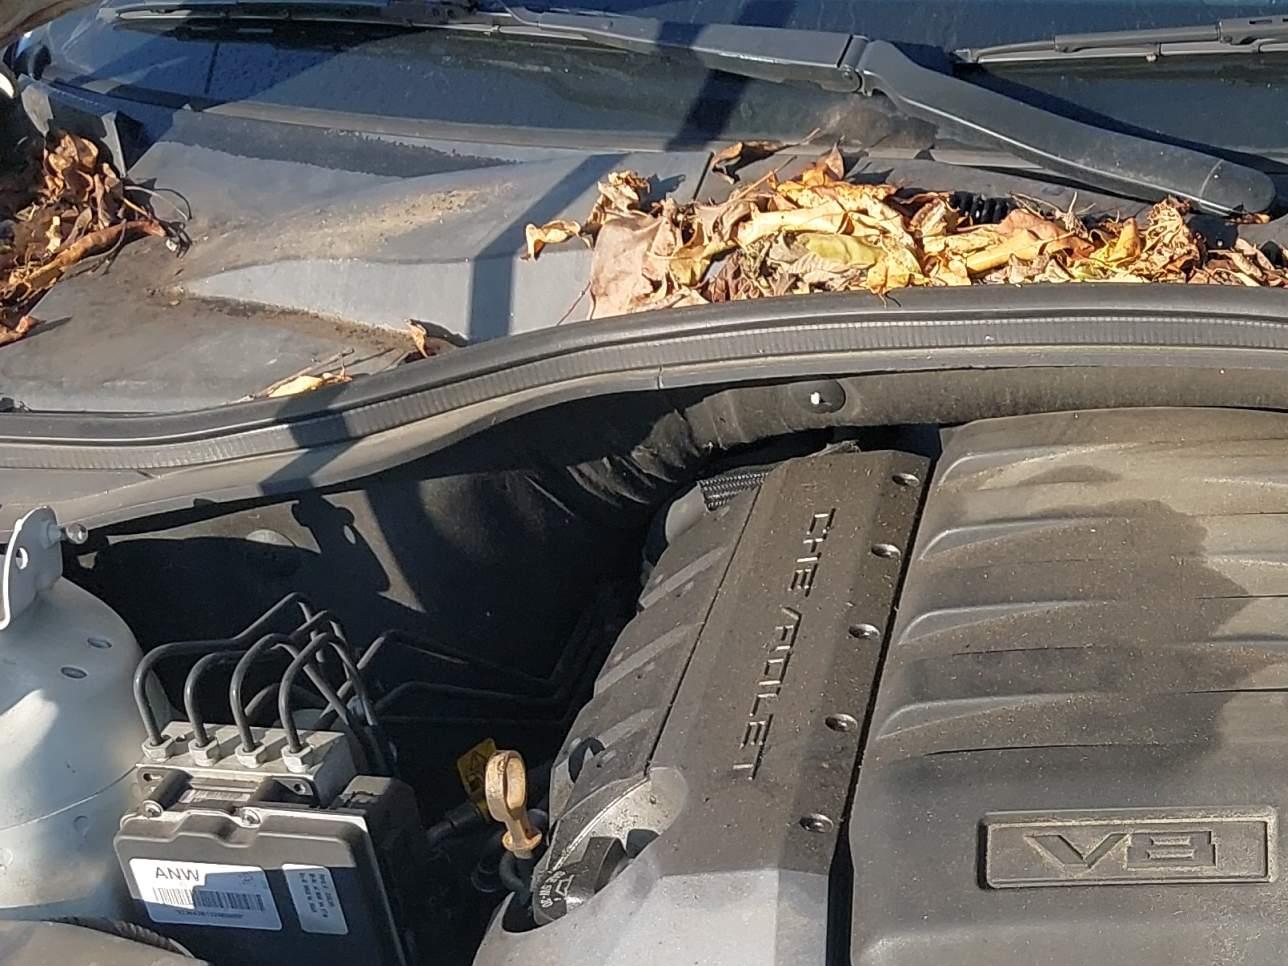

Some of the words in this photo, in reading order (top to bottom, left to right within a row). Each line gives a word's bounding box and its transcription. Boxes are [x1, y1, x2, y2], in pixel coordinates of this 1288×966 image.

[732, 507, 836, 781] CHEVROLET
[155, 866, 200, 882] ANW
[1023, 830, 1218, 876] V8
